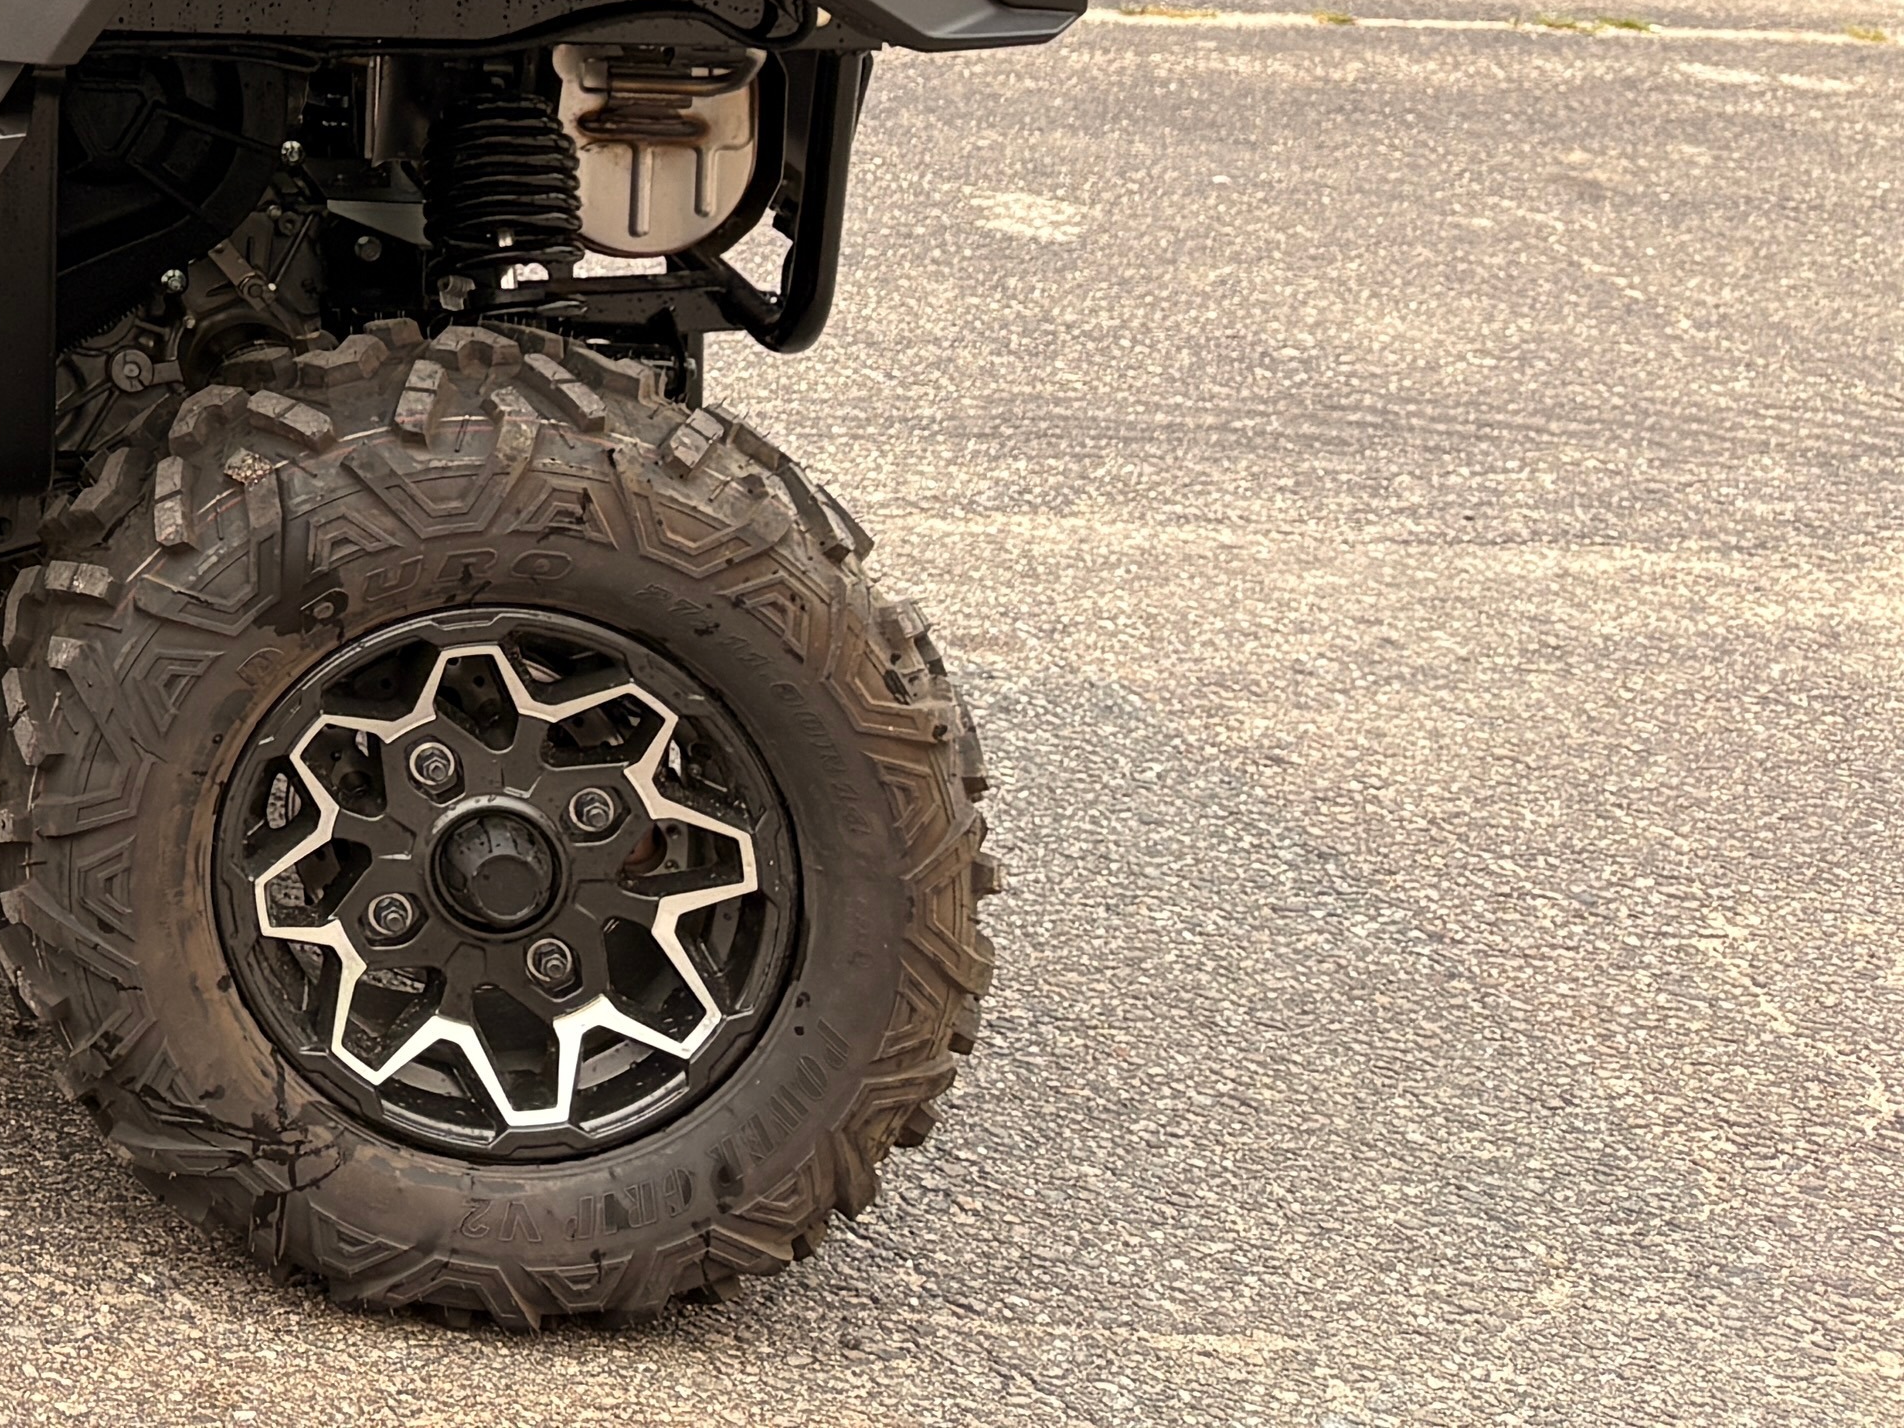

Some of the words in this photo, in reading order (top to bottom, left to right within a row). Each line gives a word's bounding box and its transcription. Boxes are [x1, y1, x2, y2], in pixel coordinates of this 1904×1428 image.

[299, 547, 574, 635] DURO
[705, 1017, 852, 1180] POWER
[458, 1198, 542, 1243] V2
[564, 1167, 696, 1241] GRIP
